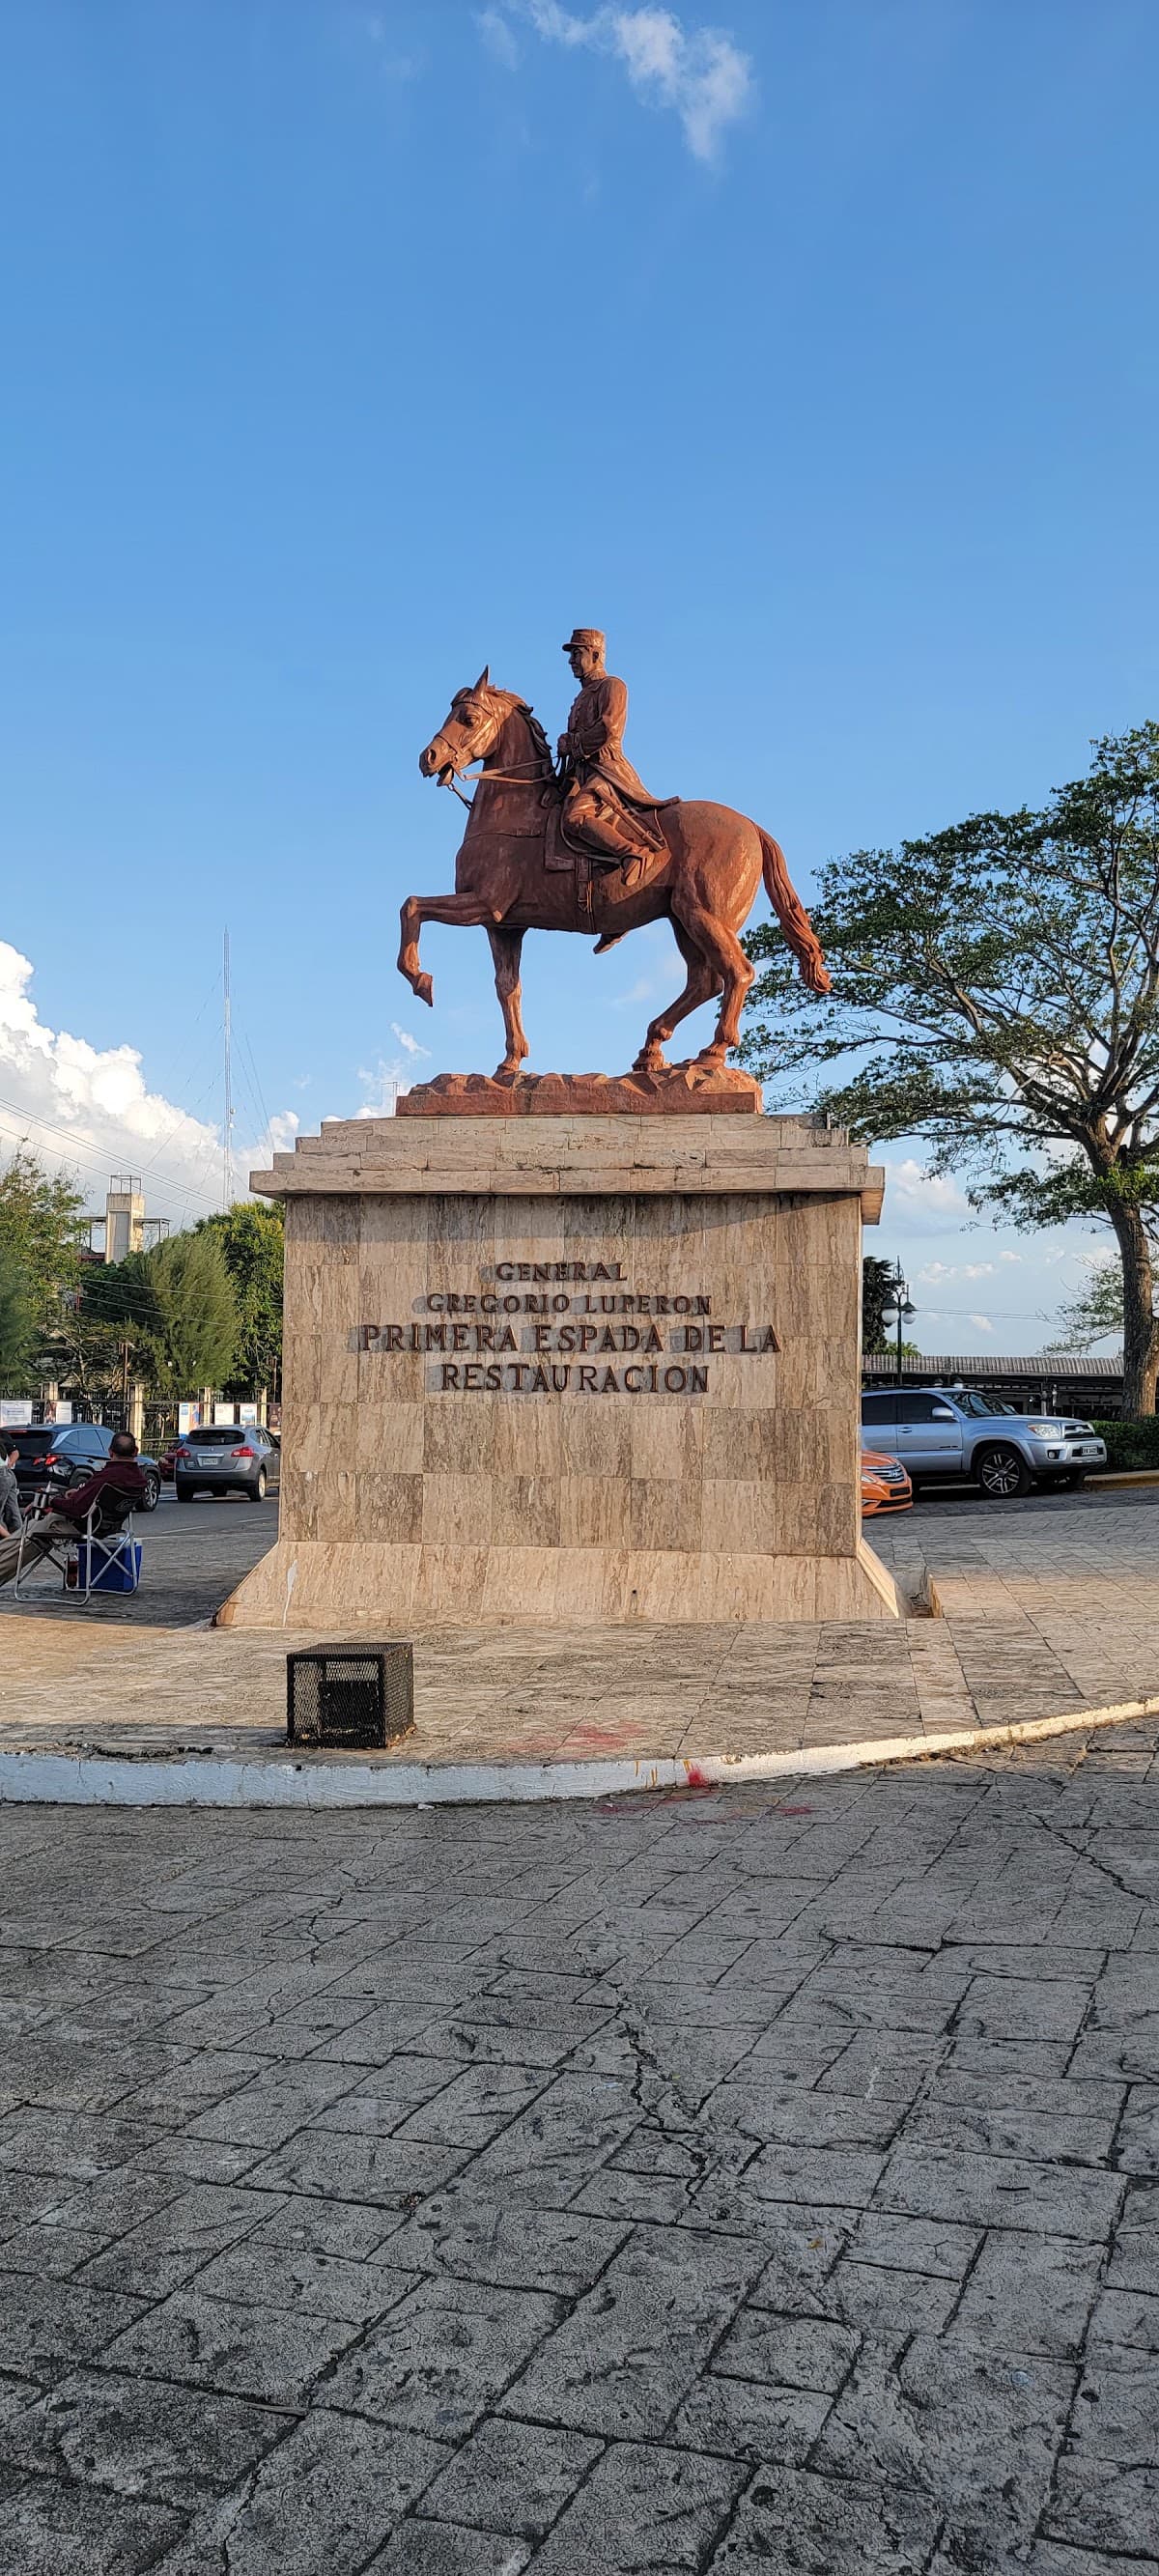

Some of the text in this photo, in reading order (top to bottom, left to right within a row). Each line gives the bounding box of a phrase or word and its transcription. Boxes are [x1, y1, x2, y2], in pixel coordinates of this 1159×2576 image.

[496, 1262, 627, 1281] GENERAL
[427, 1293, 712, 1315] GREGORIO LUPERON
[363, 1322, 780, 1352] PRIMERA ESPADA DE LA
[441, 1363, 709, 1393] RESTAURACION
